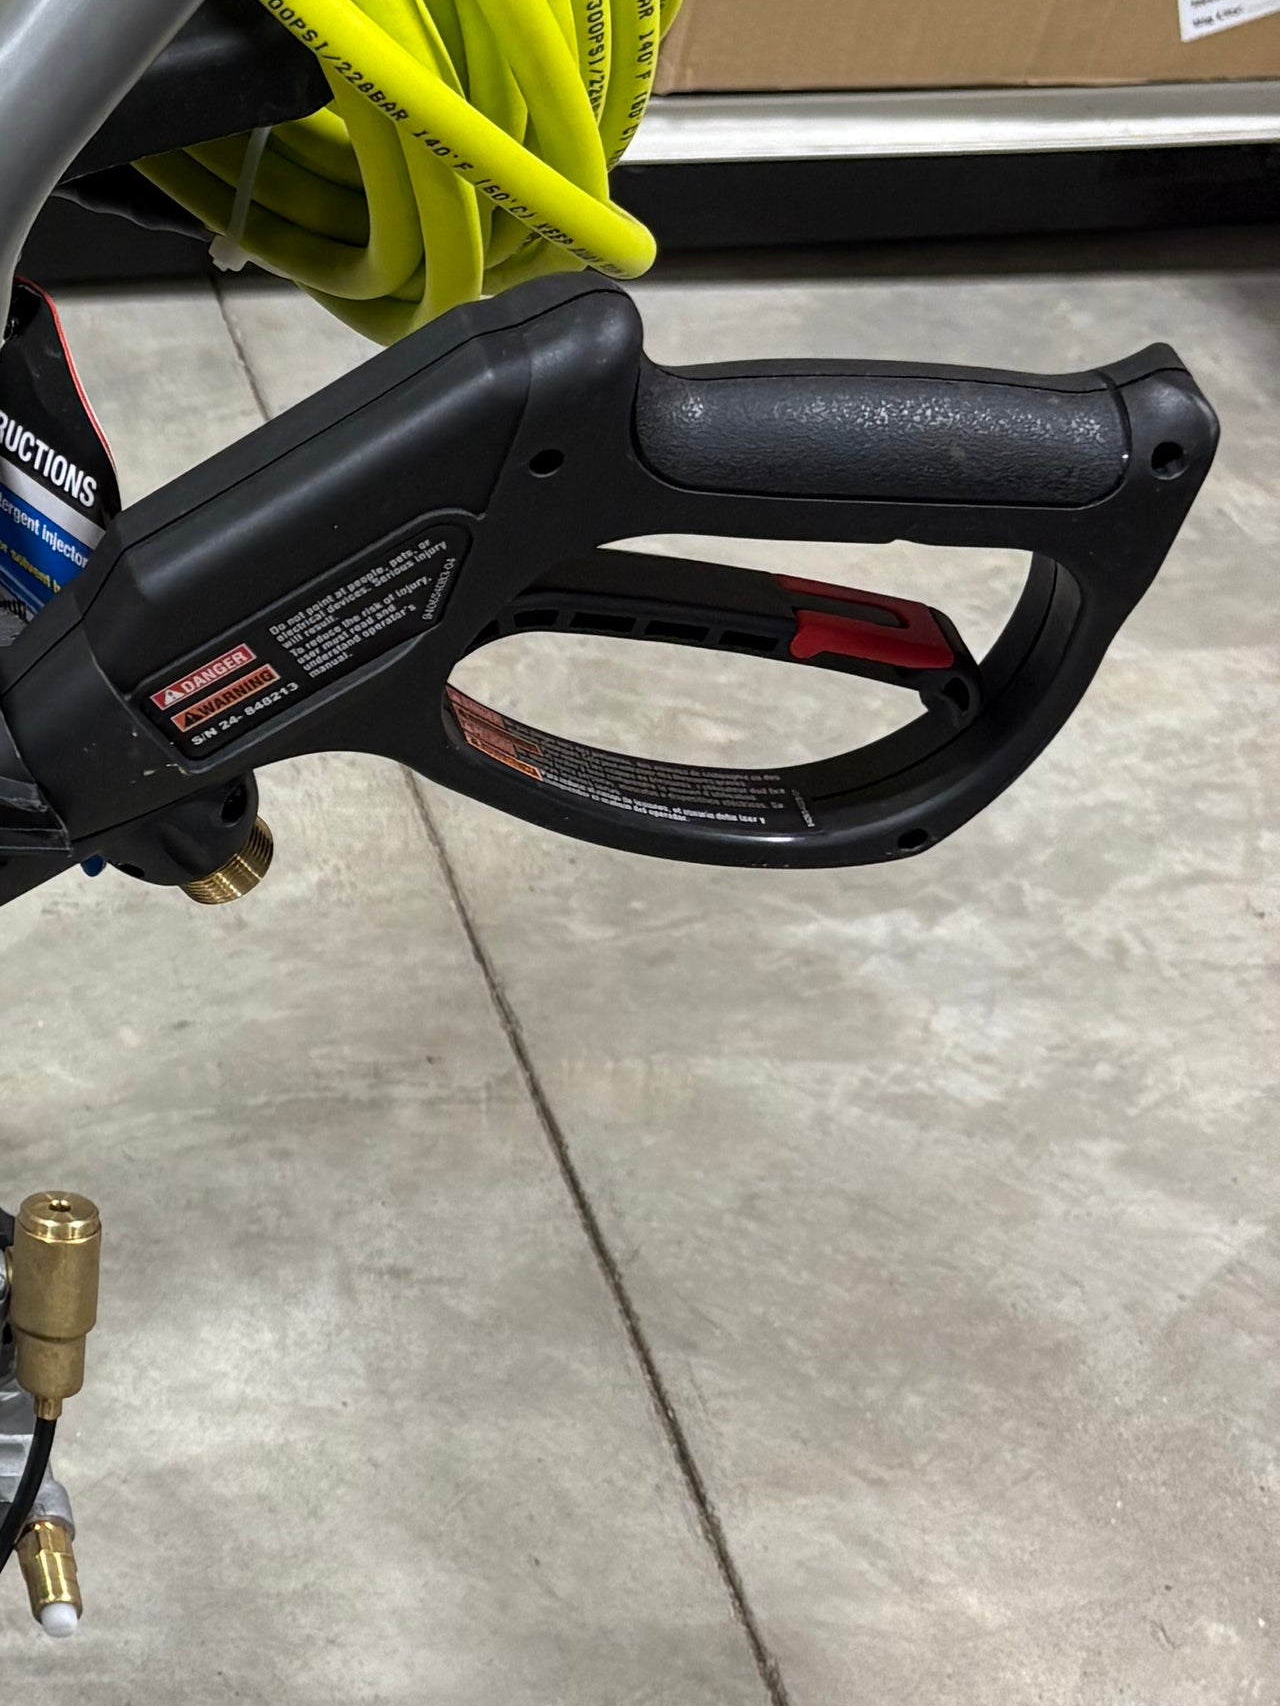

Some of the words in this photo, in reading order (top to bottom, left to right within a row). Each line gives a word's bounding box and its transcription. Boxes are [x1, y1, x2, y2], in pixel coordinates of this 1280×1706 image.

[41, 523, 89, 569] injector
[269, 622, 287, 636] Do
[287, 611, 306, 627] not
[306, 595, 336, 616] point
[275, 609, 327, 643] electrical
[371, 560, 415, 587] Serious
[414, 541, 448, 564] injury
[282, 633, 304, 650] will
[296, 647, 321, 665] user
[321, 631, 350, 653] must
[349, 617, 375, 636] read
[375, 603, 397, 622] and
[303, 633, 363, 672] understand
[363, 603, 418, 640] operator's
[305, 625, 343, 650] reduce
[341, 612, 362, 629] the
[361, 602, 383, 620] risk
[181, 651, 249, 694] DANGER
[308, 652, 354, 679] manual.
[191, 727, 219, 746] S/N
[243, 682, 300, 717] 848213
[197, 669, 276, 717] WARNING
